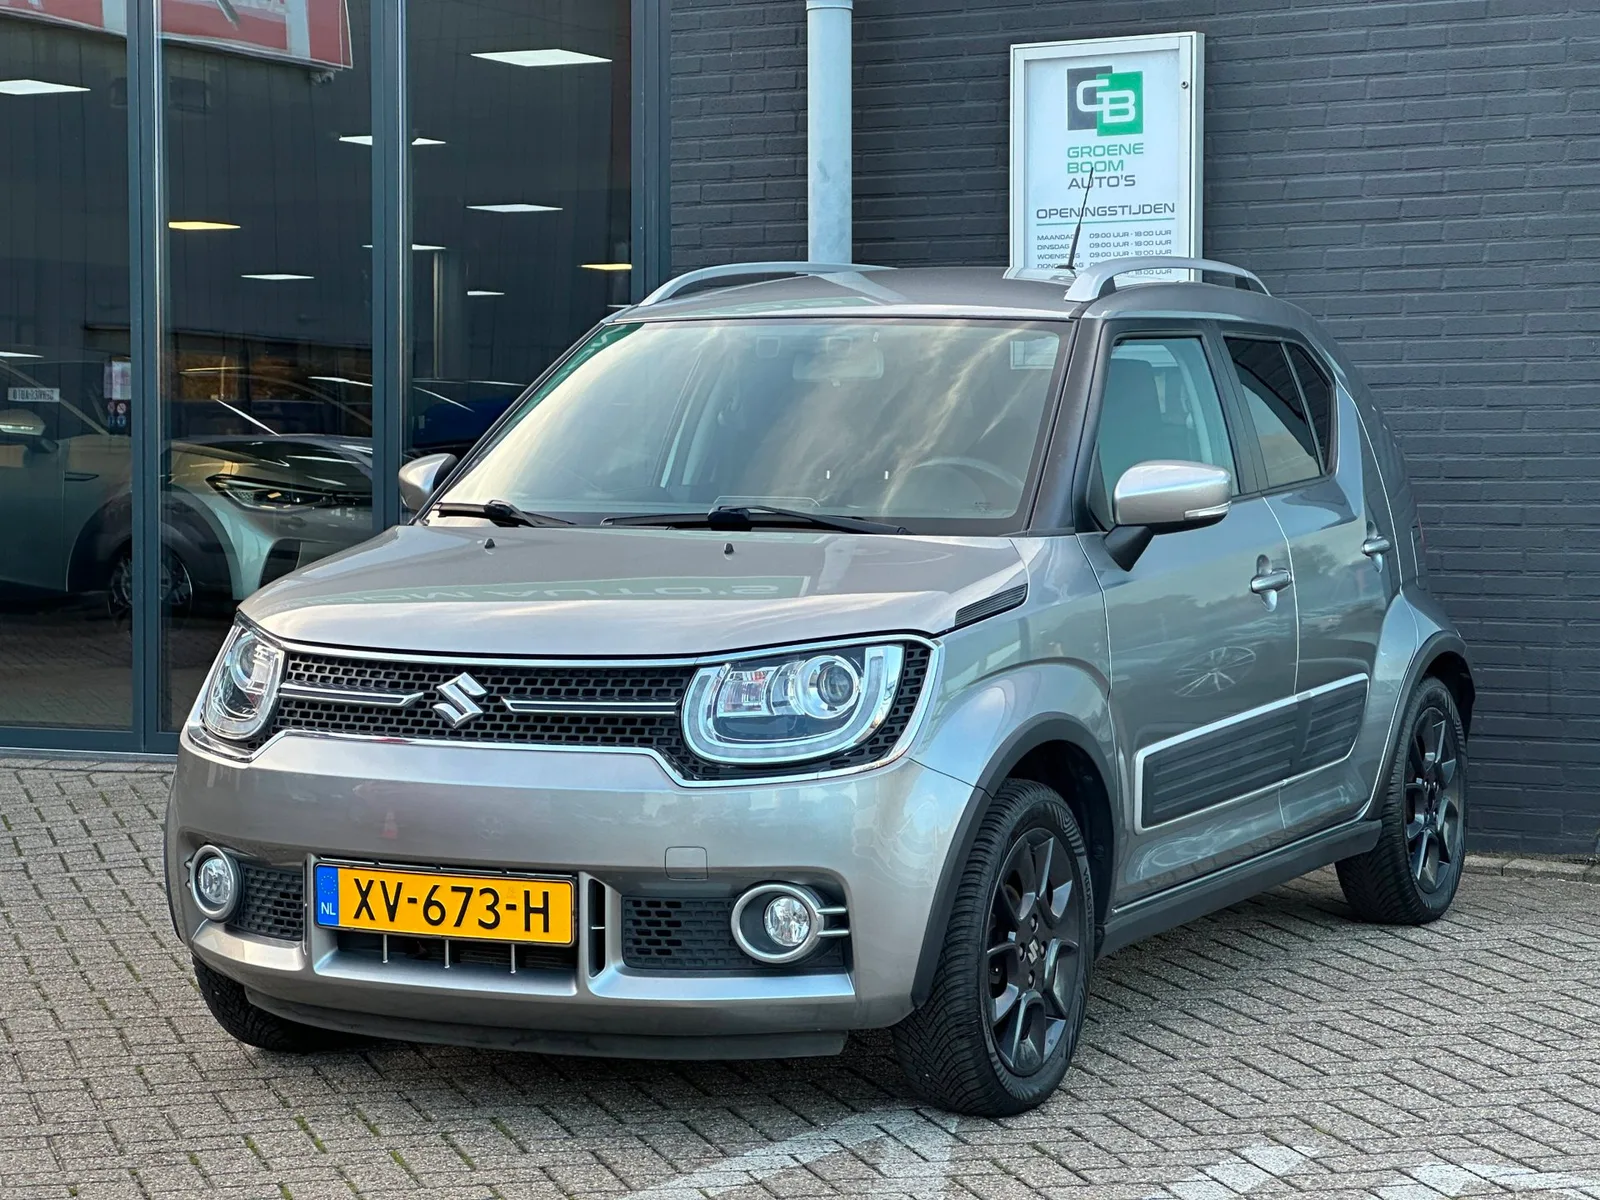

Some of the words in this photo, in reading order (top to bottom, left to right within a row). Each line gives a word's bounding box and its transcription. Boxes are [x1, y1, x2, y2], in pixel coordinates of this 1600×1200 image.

[1067, 142, 1144, 158] GROENE
[1067, 159, 1124, 174] BOOM
[1067, 174, 1136, 190] AUTO'S
[1036, 202, 1175, 219] OPENNGSTIJDEN
[1037, 243, 1070, 251] DINSDAG
[321, 901, 337, 916] NL
[352, 877, 550, 933] XV-673-H
